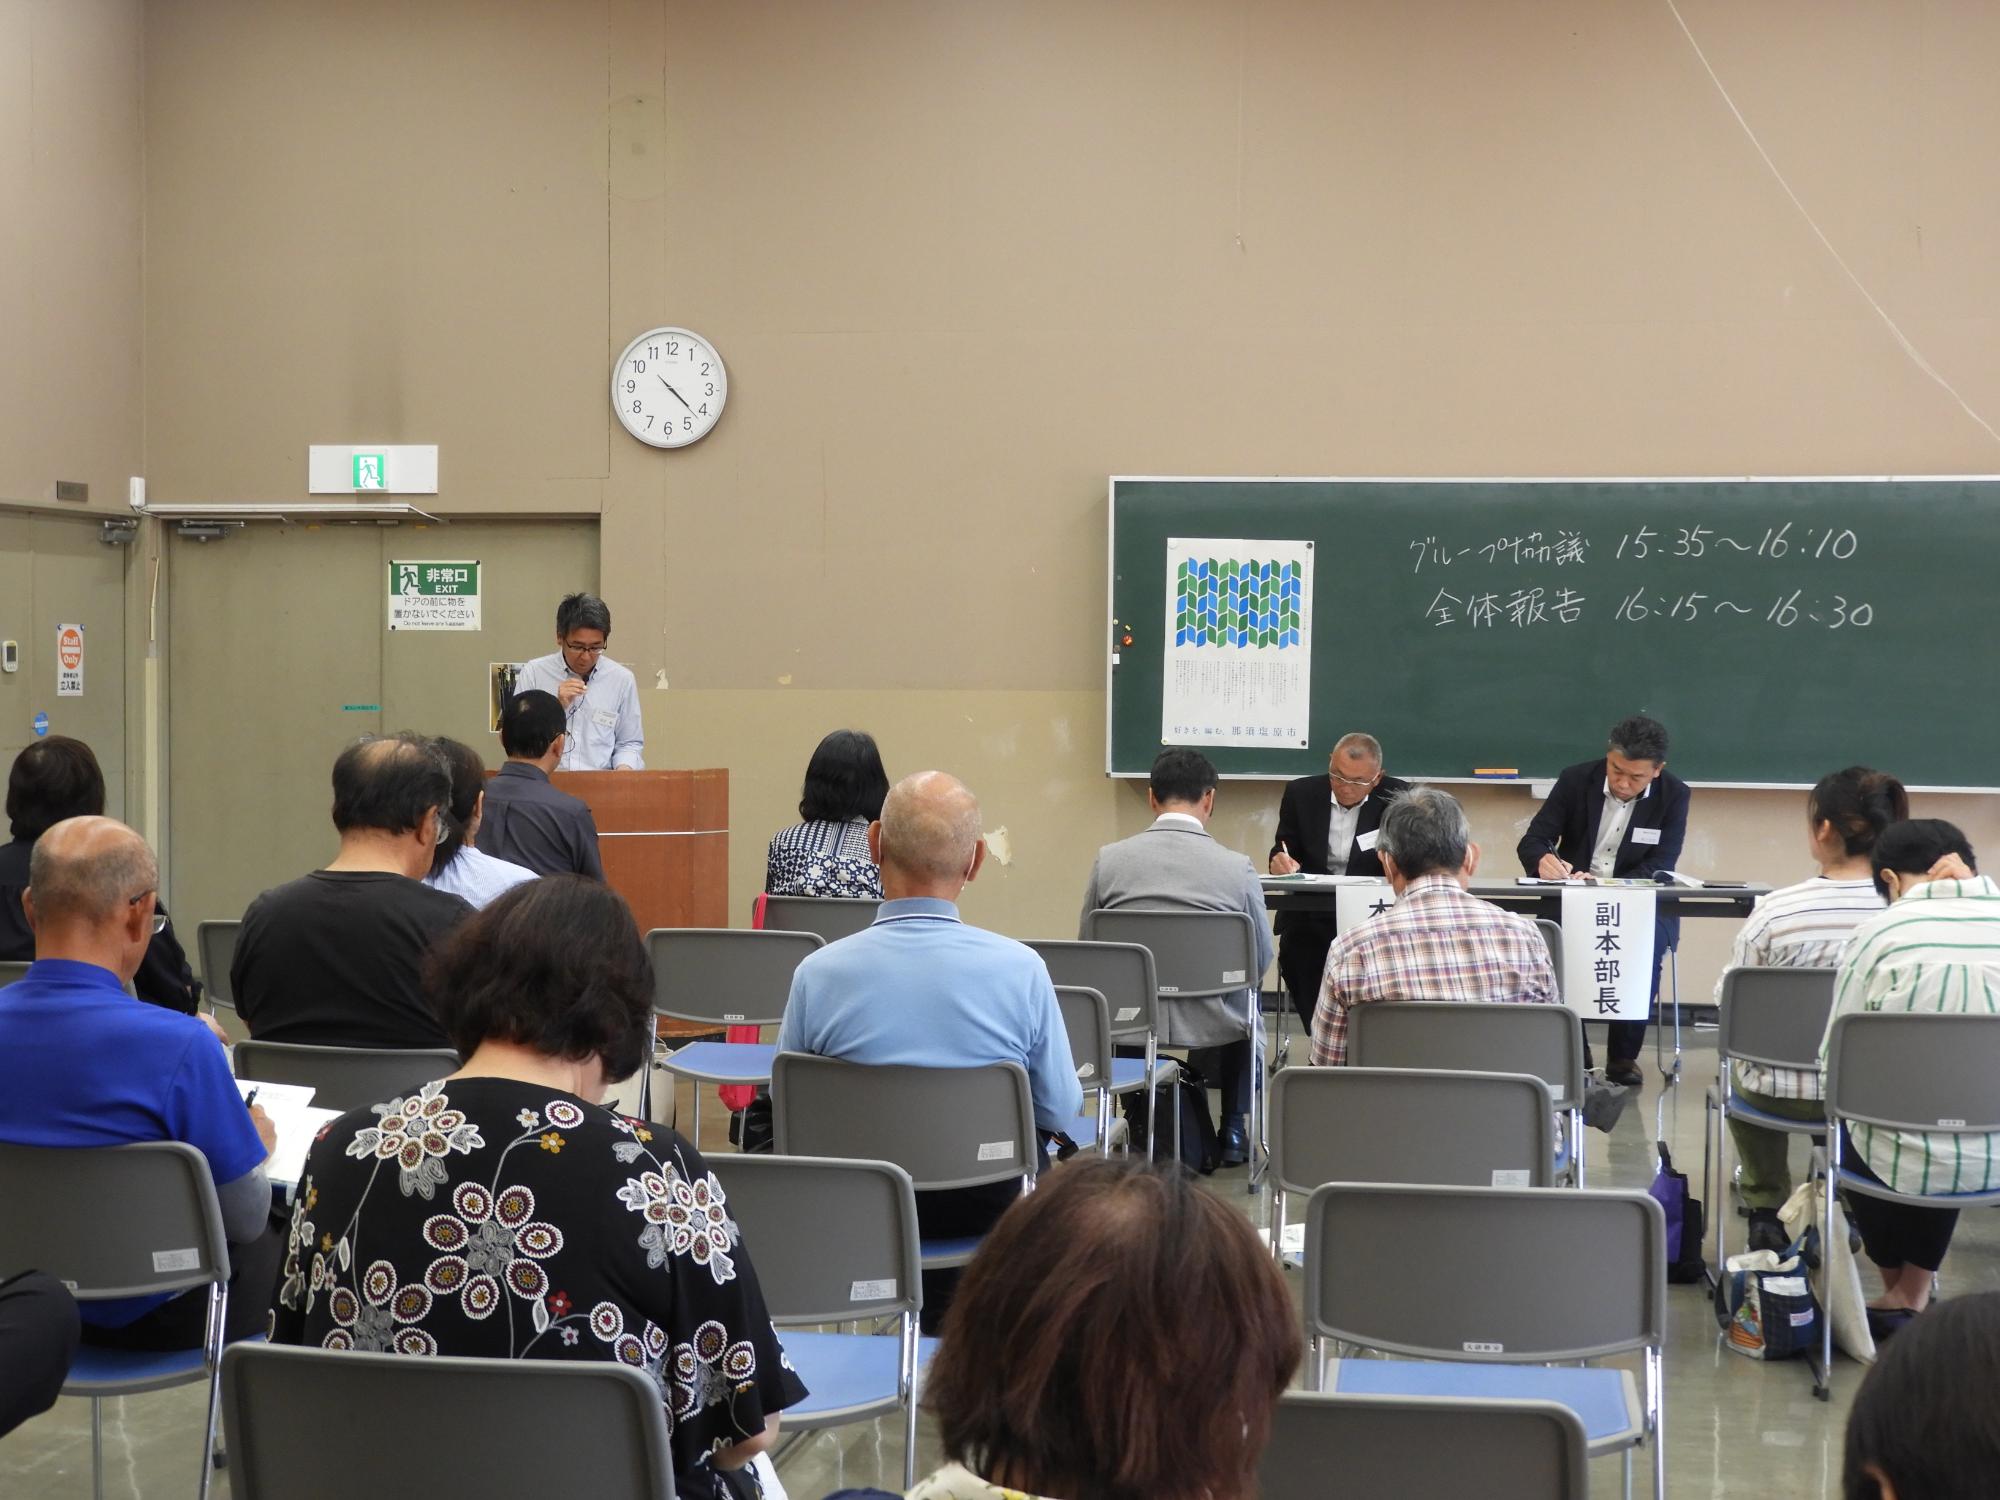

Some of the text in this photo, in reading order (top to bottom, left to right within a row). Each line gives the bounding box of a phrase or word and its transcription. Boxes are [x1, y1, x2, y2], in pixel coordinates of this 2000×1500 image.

[648, 347, 659, 360] 11
[666, 342, 679, 355] 12
[689, 348, 693, 361] 1
[633, 360, 645, 373] 10
[701, 362, 709, 376] 2
[627, 380, 635, 393] 9
[705, 383, 713, 396] 3
[633, 400, 641, 413] 8
[698, 403, 707, 416] 4
[646, 416, 654, 429] 7
[664, 422, 672, 435] 6
[683, 417, 691, 430] 5
[1410, 530, 1591, 574] グループ協議
[426, 568, 468, 583] 非常口
[435, 585, 459, 594] EXIT
[404, 598, 465, 607] ドアの前に物を
[1425, 587, 1586, 628] 全体報告
[394, 609, 476, 619] 置かないでください
[64, 637, 79, 645] Staff
[64, 654, 78, 664] Only
[60, 681, 80, 691] 立入禁止
[1231, 726, 1297, 737] 那須塩原市
[1592, 902, 1622, 1015] 副本部長
